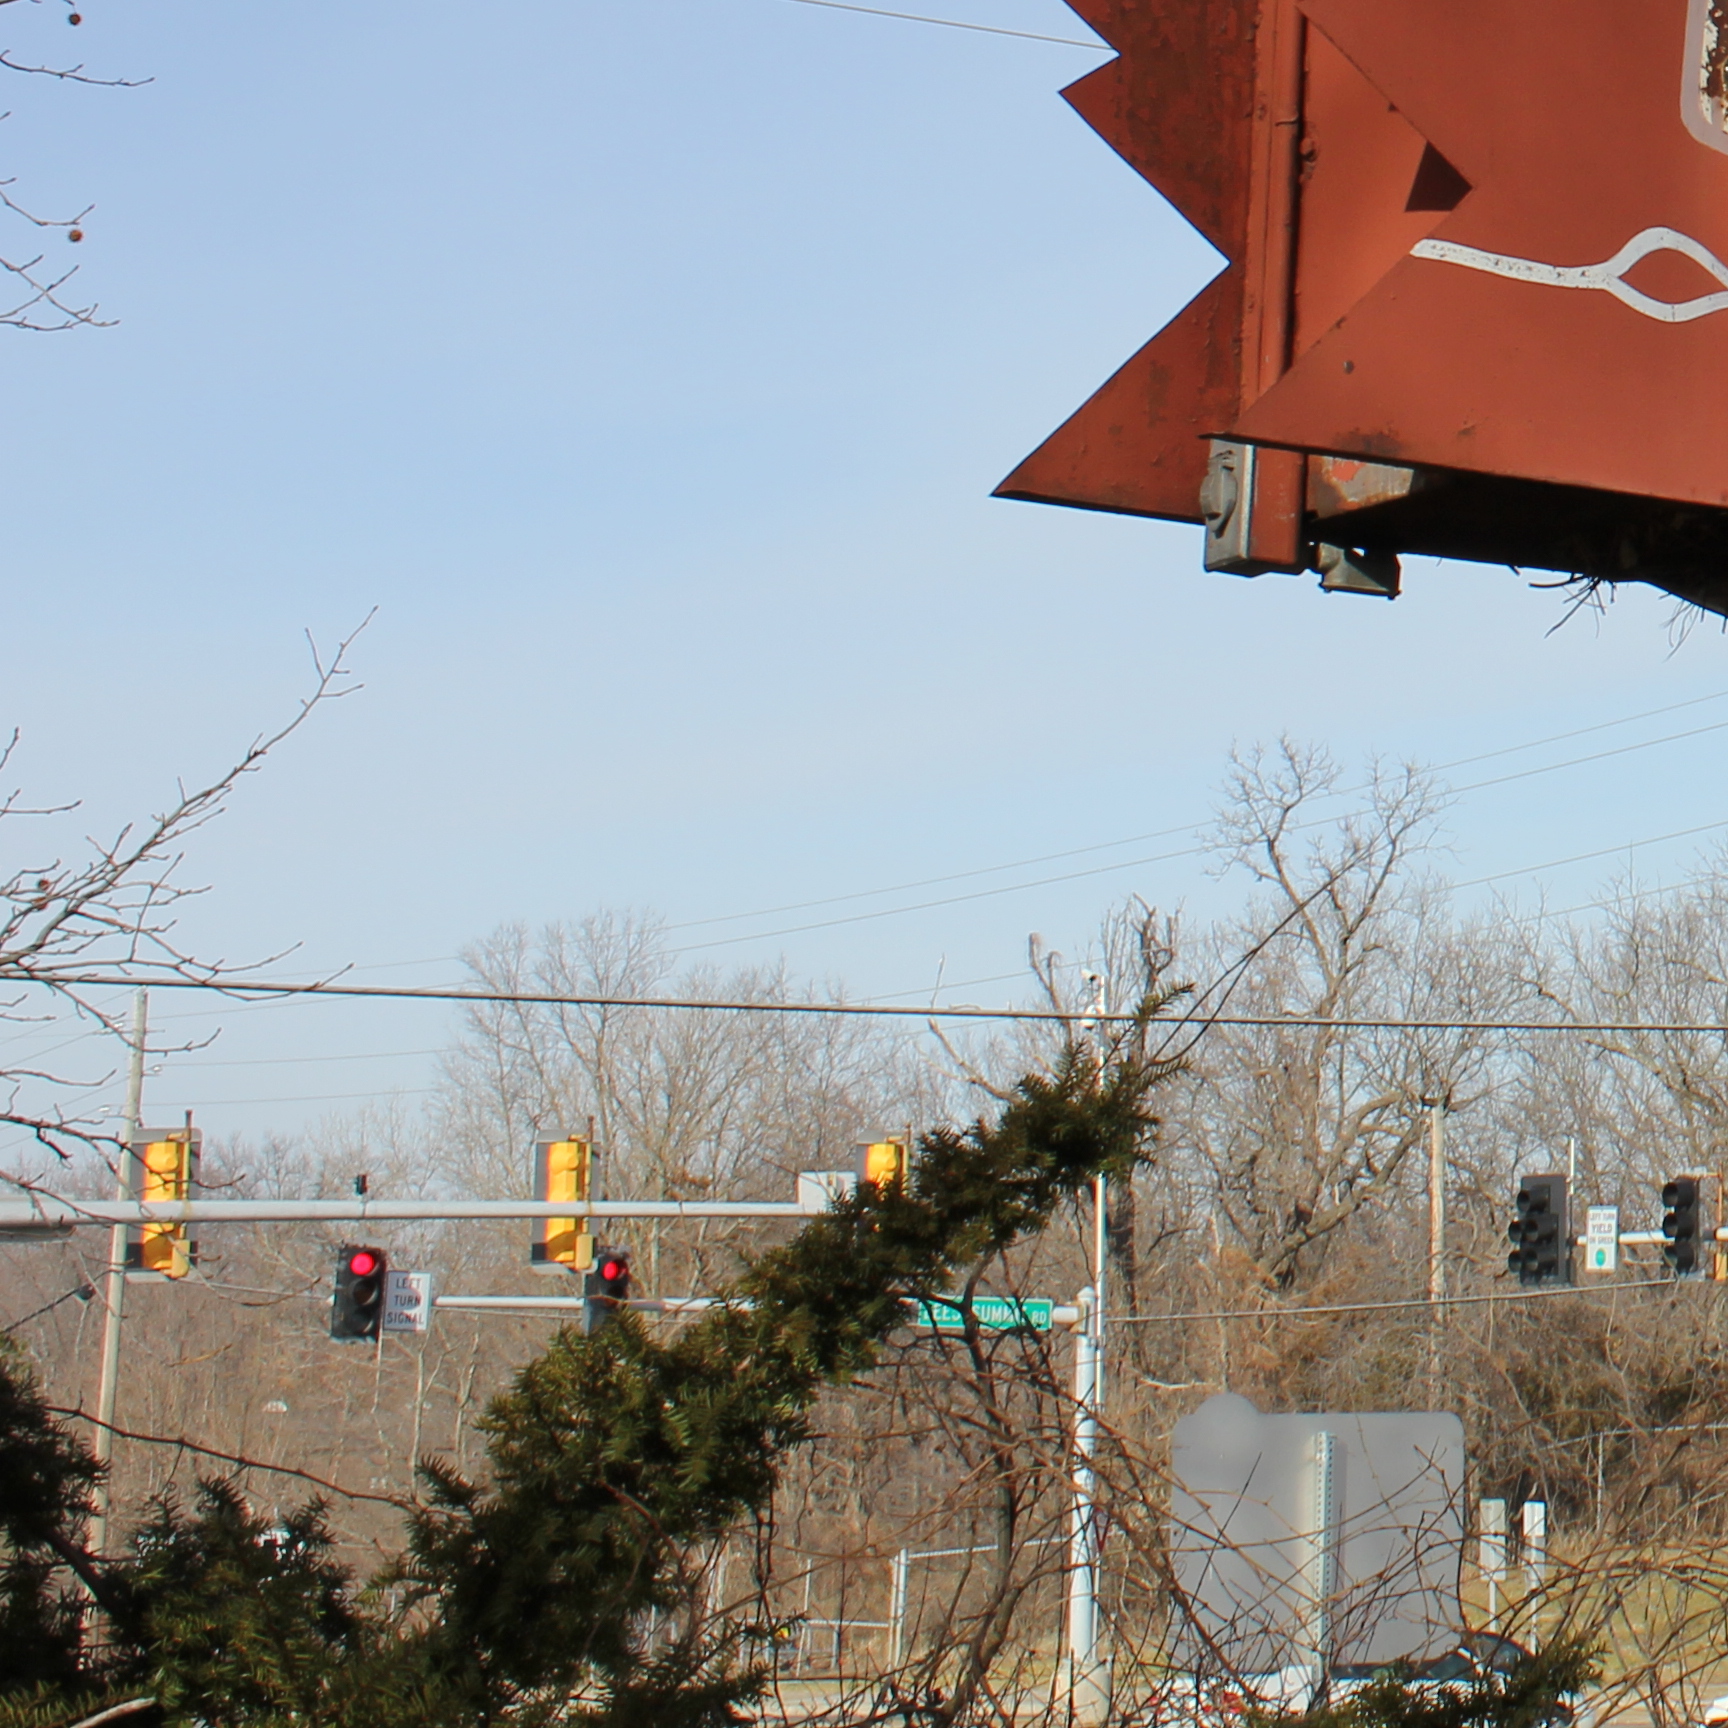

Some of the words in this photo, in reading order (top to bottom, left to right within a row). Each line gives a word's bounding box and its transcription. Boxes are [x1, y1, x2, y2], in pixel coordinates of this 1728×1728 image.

[396, 1277, 421, 1289] LEFT
[394, 1295, 421, 1306] TURN
[386, 1312, 424, 1324] SIGNAL
